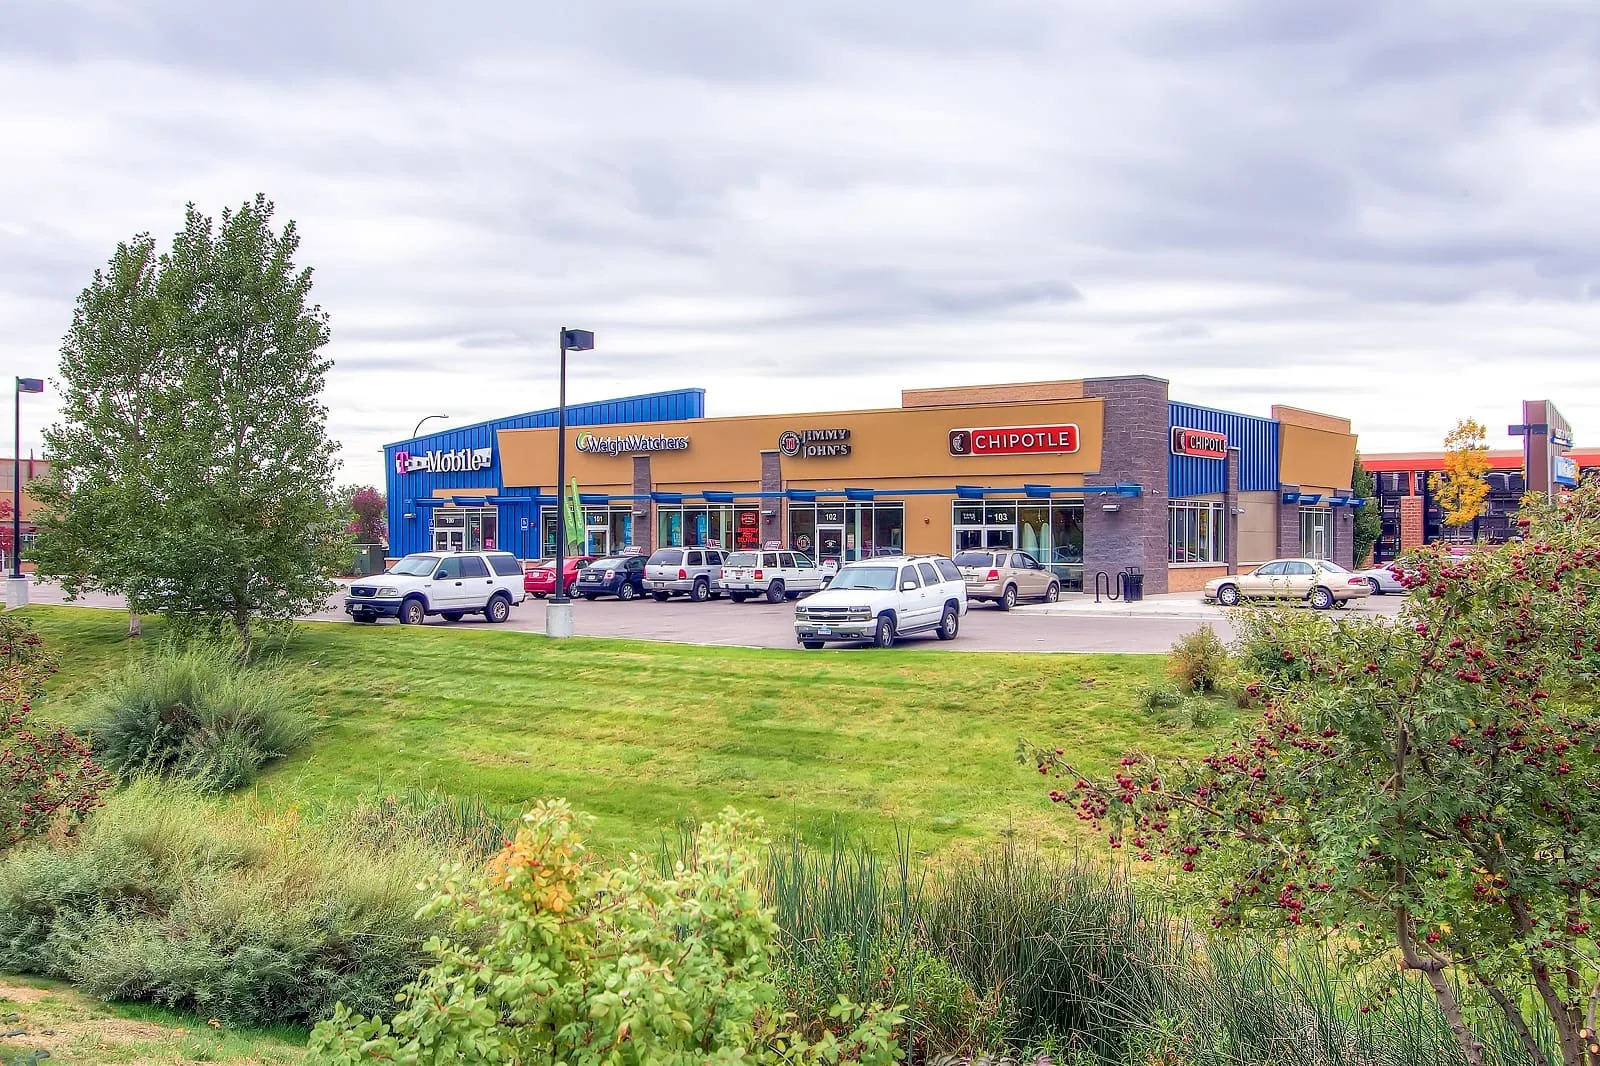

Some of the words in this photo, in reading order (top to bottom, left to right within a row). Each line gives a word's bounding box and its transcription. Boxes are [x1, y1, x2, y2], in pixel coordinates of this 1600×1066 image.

[801, 429, 846, 443] JIMMY
[975, 432, 1070, 449] CHIPOTLE
[1190, 435, 1228, 453] CHIPOTLE
[802, 445, 848, 459] JOHN'S
[825, 513, 837, 521] 102
[994, 512, 1008, 521] 103
